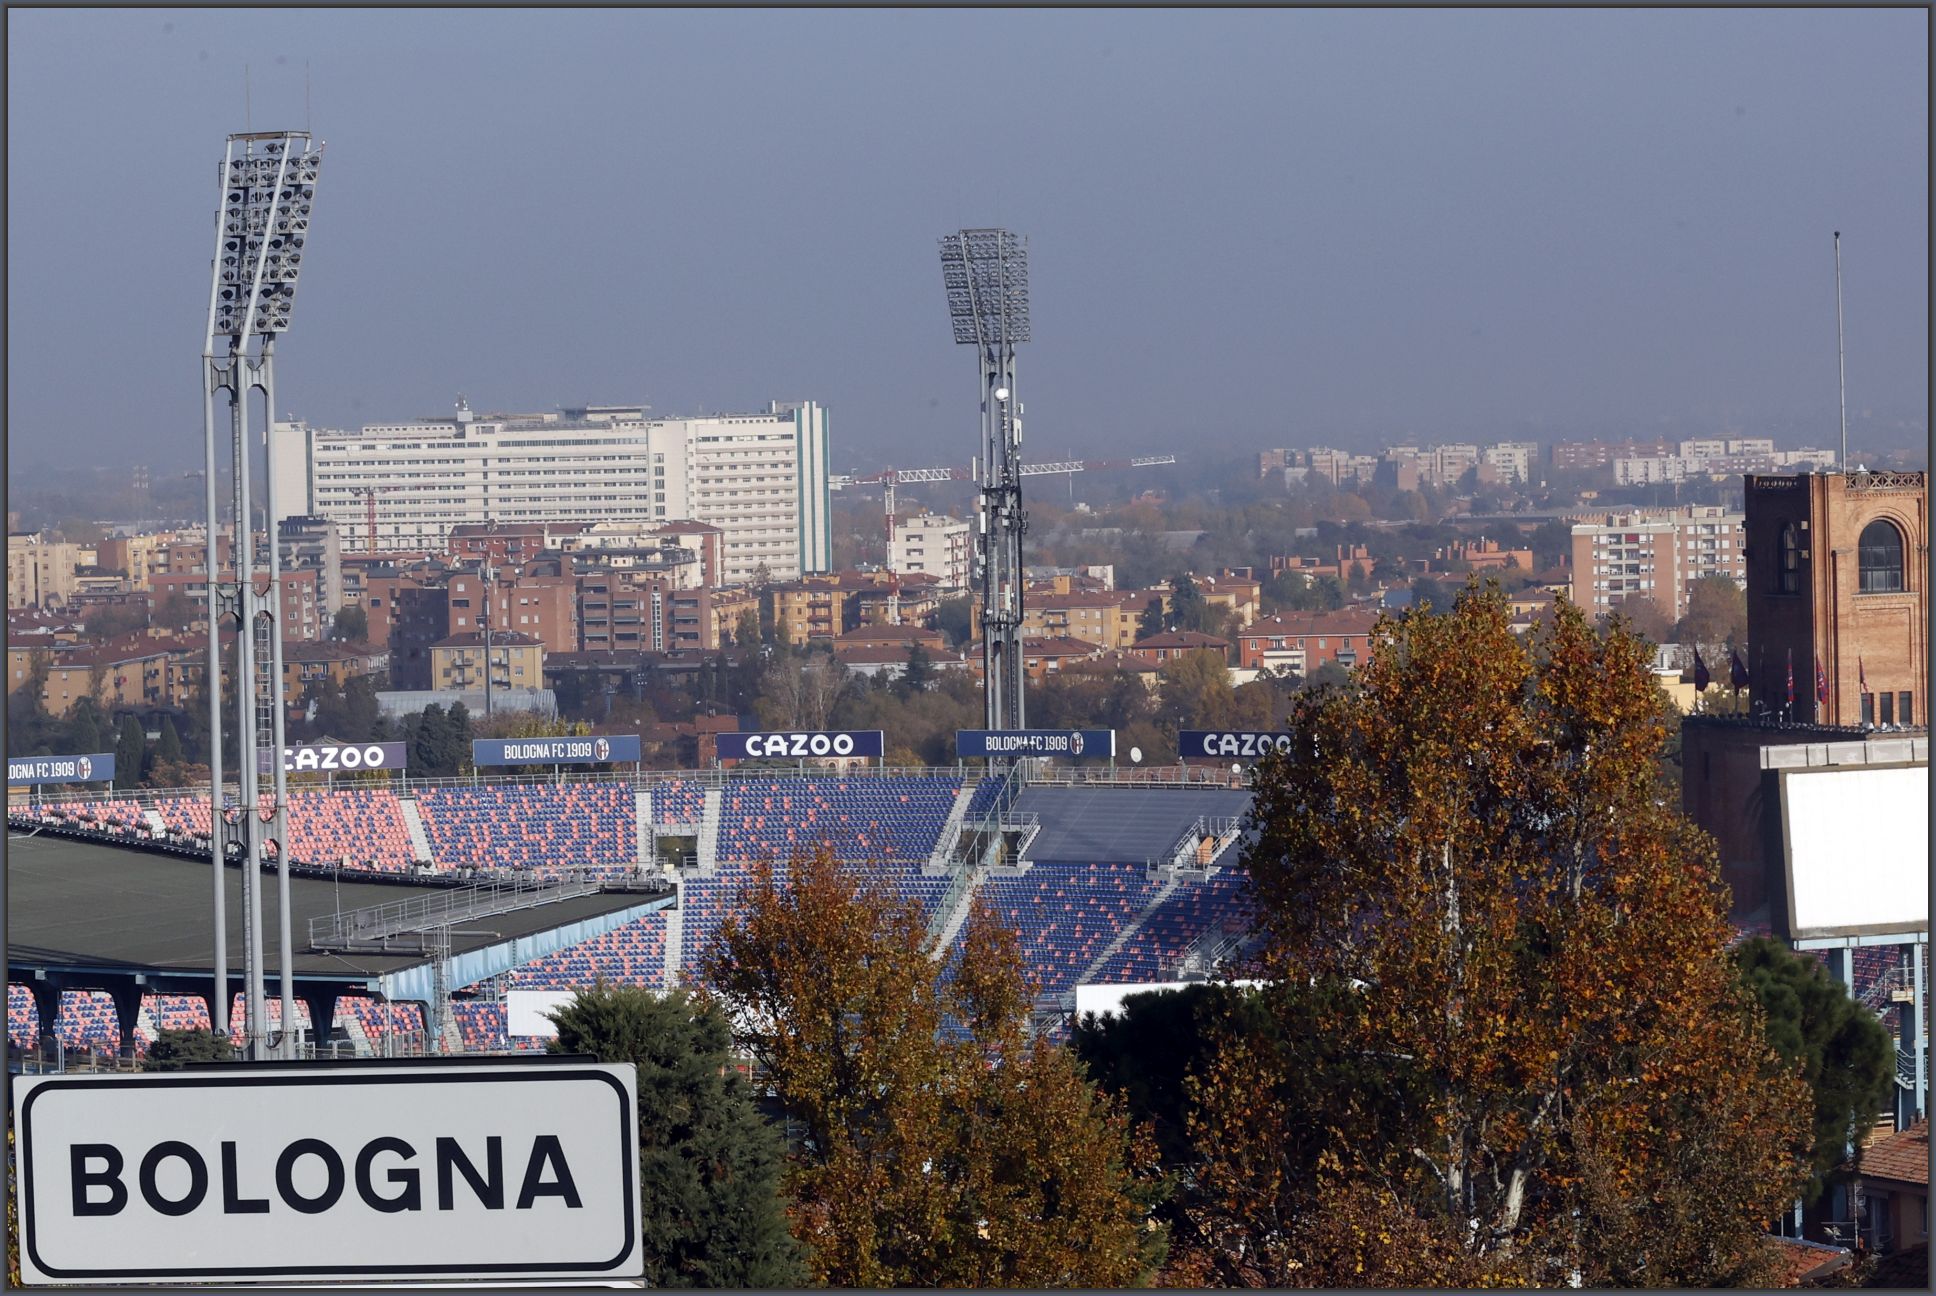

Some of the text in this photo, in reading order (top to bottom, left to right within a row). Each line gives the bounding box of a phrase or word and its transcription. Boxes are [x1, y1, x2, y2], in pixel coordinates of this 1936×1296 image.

[504, 742, 591, 759] BOLOGNA FC 1909
[745, 734, 854, 756] CAZOO
[986, 736, 1068, 750] BOLOGNA FC 1909
[1203, 733, 1291, 756] CAZOO
[8, 762, 74, 779] OGNA FC 1909
[70, 1135, 583, 1216] BOLOGNA
